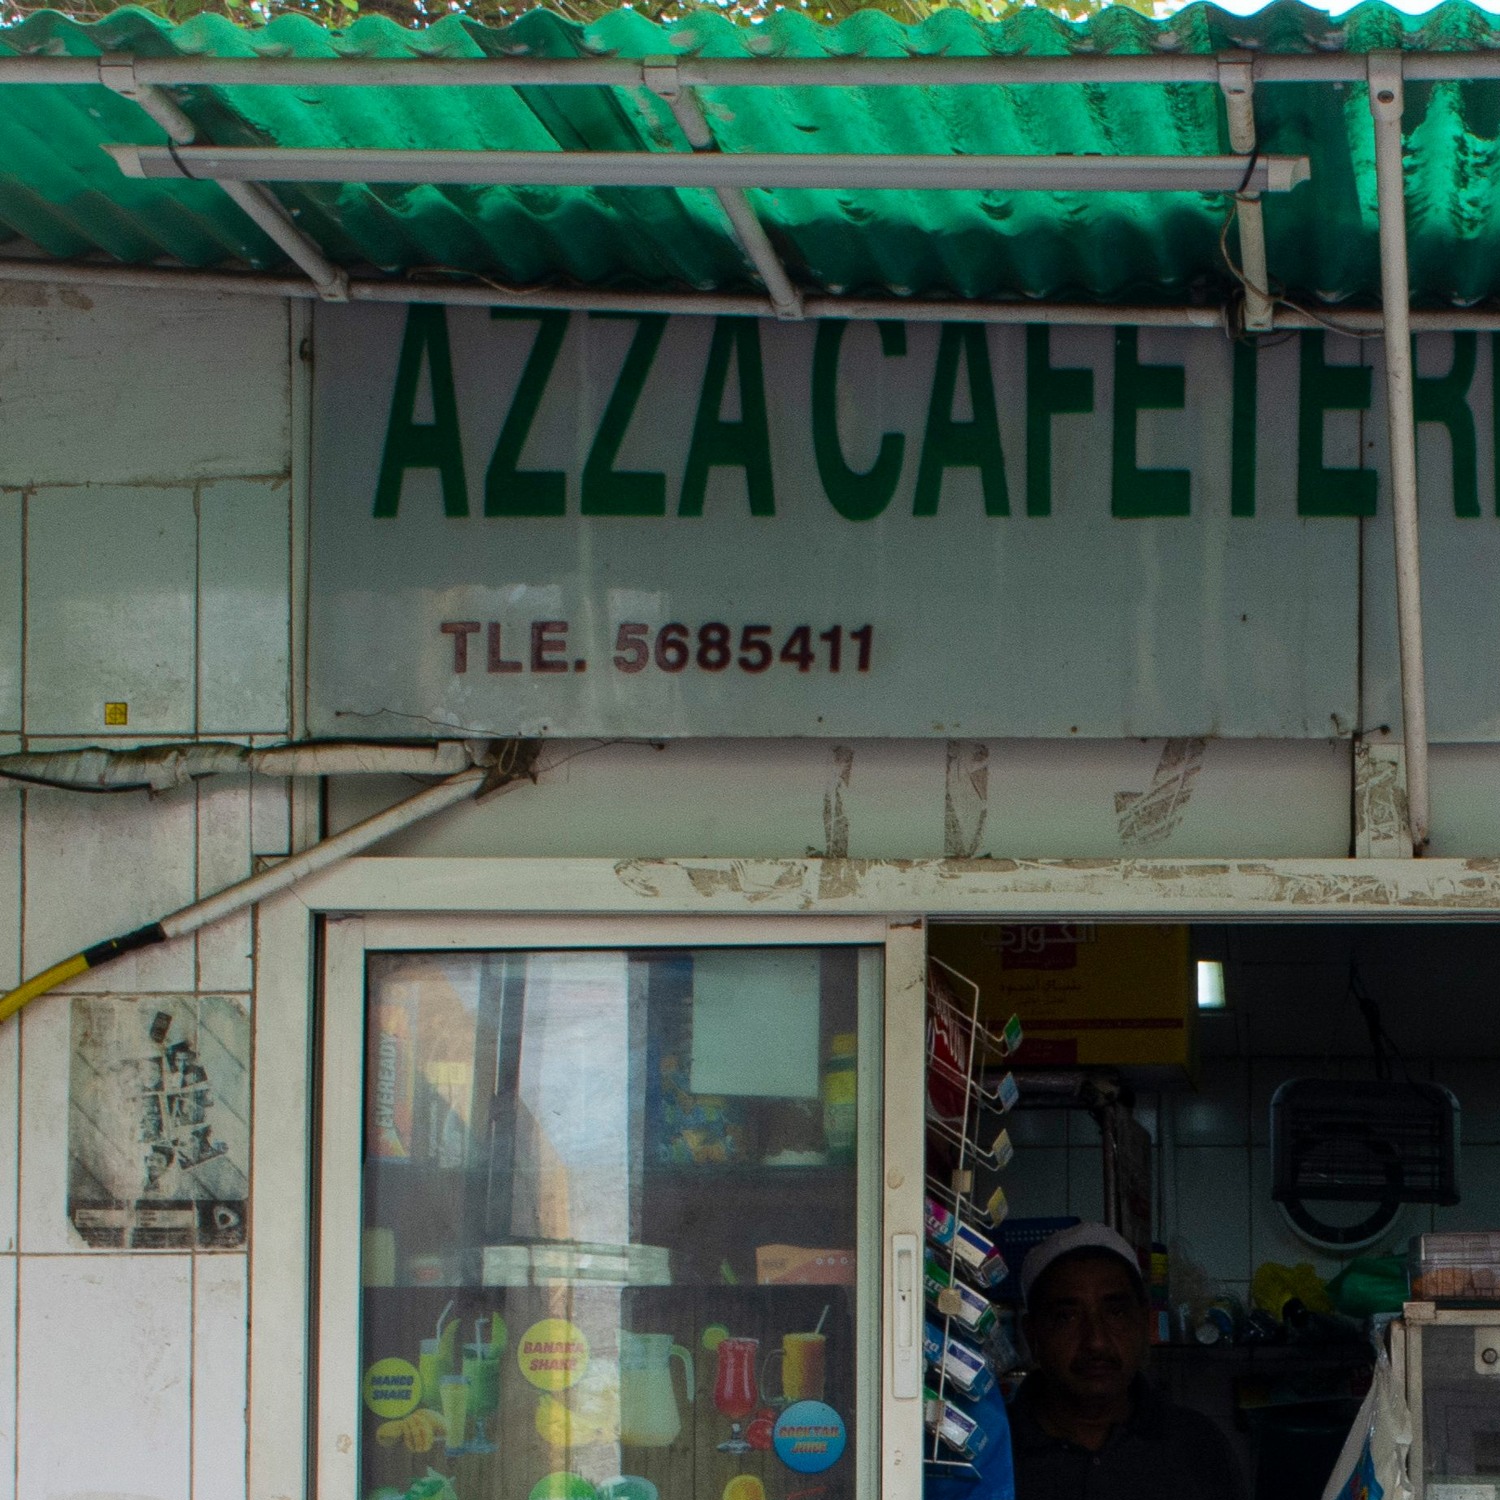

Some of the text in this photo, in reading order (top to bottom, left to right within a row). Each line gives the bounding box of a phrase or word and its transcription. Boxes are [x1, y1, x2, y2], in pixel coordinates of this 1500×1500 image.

[373, 302, 775, 519] AZZA
[439, 619, 873, 674] TLE. 5685411
[375, 1032, 398, 1128] EVEREADY
[523, 1341, 584, 1355] BANANA
[529, 1358, 577, 1372] SHAKE
[371, 1375, 413, 1387] MANGO
[372, 1389, 413, 1401] SHAKE
